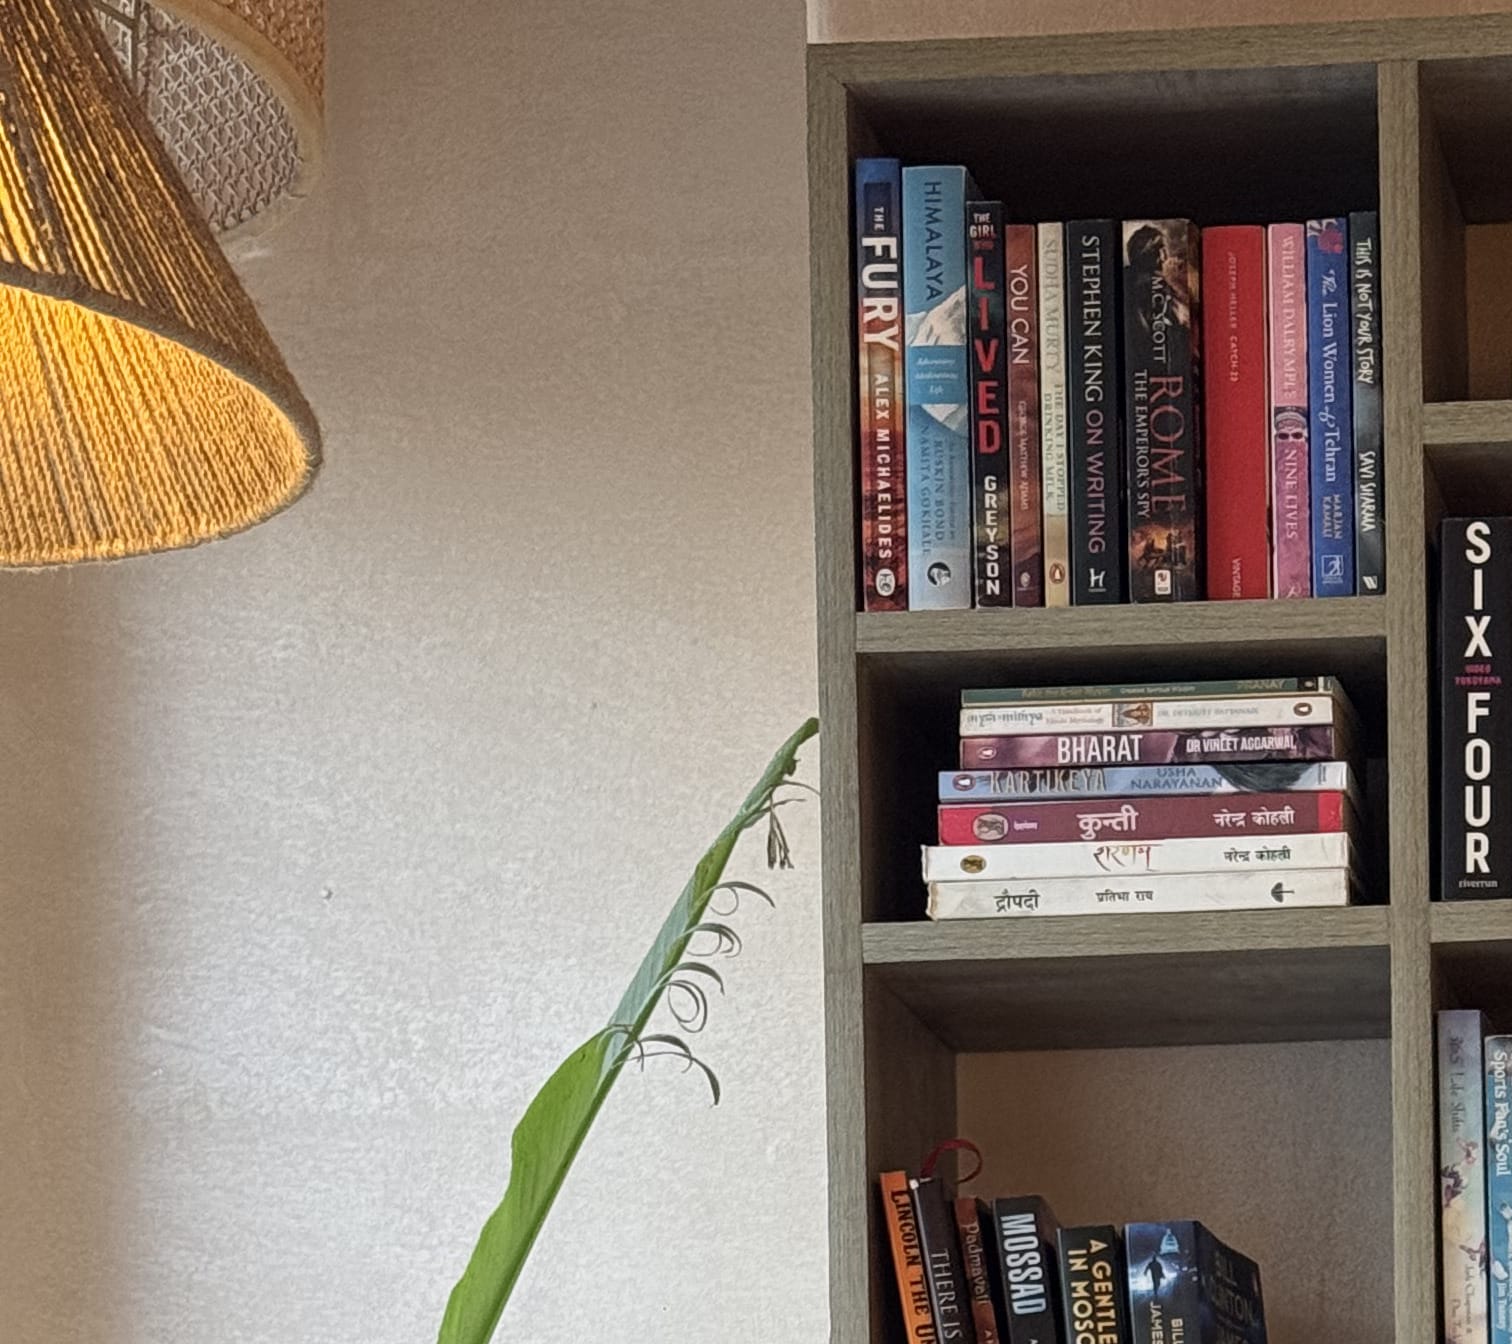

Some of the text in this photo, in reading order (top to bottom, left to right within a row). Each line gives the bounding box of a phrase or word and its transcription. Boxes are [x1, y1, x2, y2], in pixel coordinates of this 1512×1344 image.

[861, 207, 897, 350] THE FURY
[924, 182, 943, 300] HIMALAYA
[1010, 264, 1029, 364] YOU CAN
[1322, 302, 1337, 337] Lion
[1356, 238, 1373, 384] THIS IS NOT YOUR STORY
[1082, 235, 1105, 554] STEPHEN KING ON WRITING
[1323, 342, 1337, 403] Women
[875, 374, 892, 559] ALEX MICHAELIDES
[1134, 370, 1151, 518] THE EMPEROR'S SPY
[1149, 376, 1185, 515] ROME
[1324, 428, 1340, 482] Tehran
[1361, 451, 1377, 532] SAVI SHARMA
[984, 476, 1000, 595] GREYSON
[1464, 522, 1492, 657] SIX
[1057, 735, 1144, 764] BHARAT
[1464, 692, 1491, 873] FOUR
[1076, 806, 1139, 839] कुन्ती
[1213, 809, 1295, 828] नरेन्द्र कोहली
[994, 890, 1039, 912] द्रौपदी
[891, 1190, 922, 1267] LINCOLN
[908, 1279, 932, 1316] THE
[929, 1250, 963, 1315] THERE
[1000, 1213, 1047, 1314] MOSSAD
[1068, 1249, 1087, 1271] IN
[1090, 1239, 1107, 1253] A
[942, 1322, 967, 1340] IS
